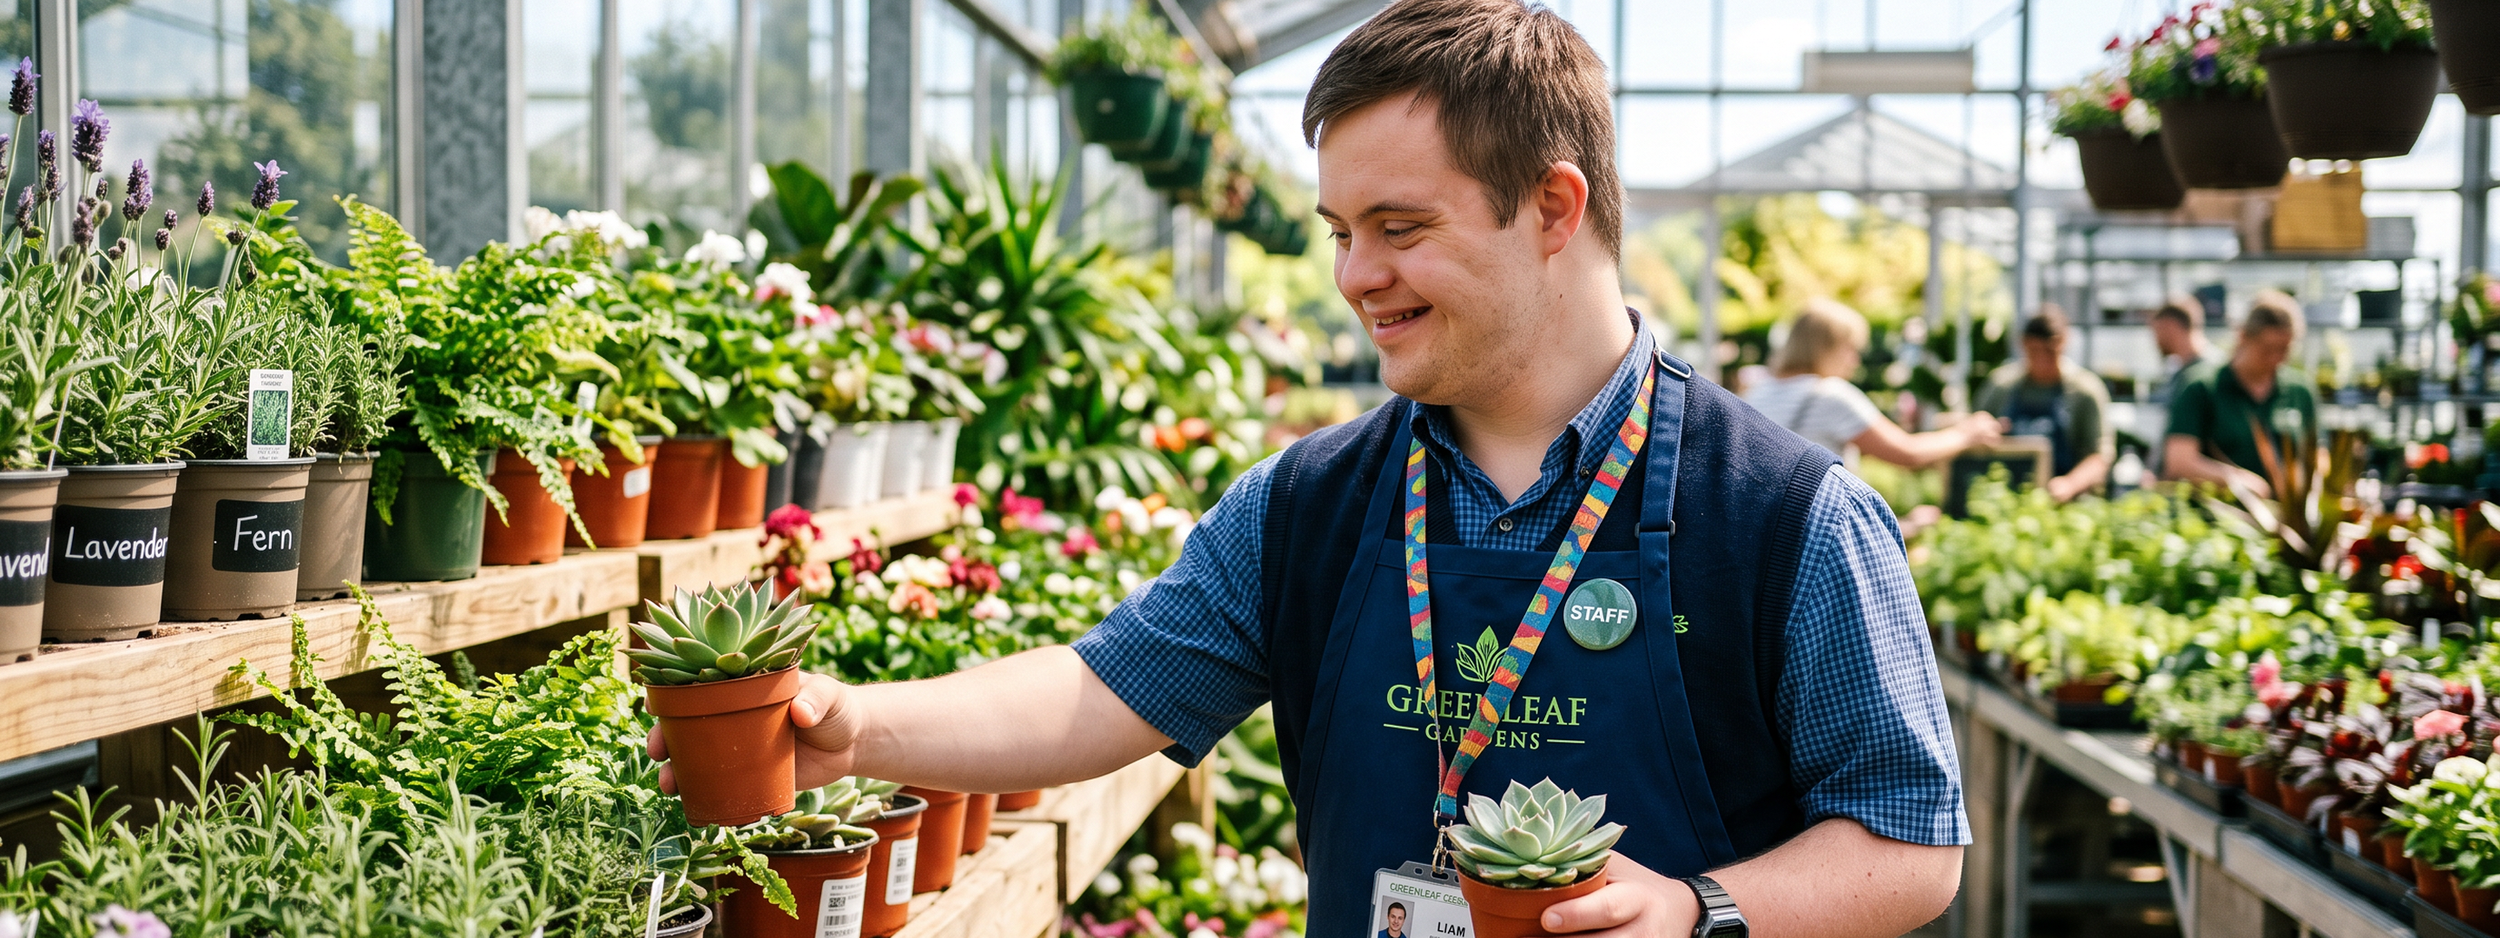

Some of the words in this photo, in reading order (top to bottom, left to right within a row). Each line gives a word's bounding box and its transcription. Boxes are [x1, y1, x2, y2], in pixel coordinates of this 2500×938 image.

[64, 526, 169, 560] Lavender
[233, 514, 293, 552] Fern
[1570, 604, 1630, 625] STAFF
[1386, 684, 1587, 726] GEELEAF
[1424, 723, 1540, 750] GAENS
[1437, 921, 1466, 938] LIAM
